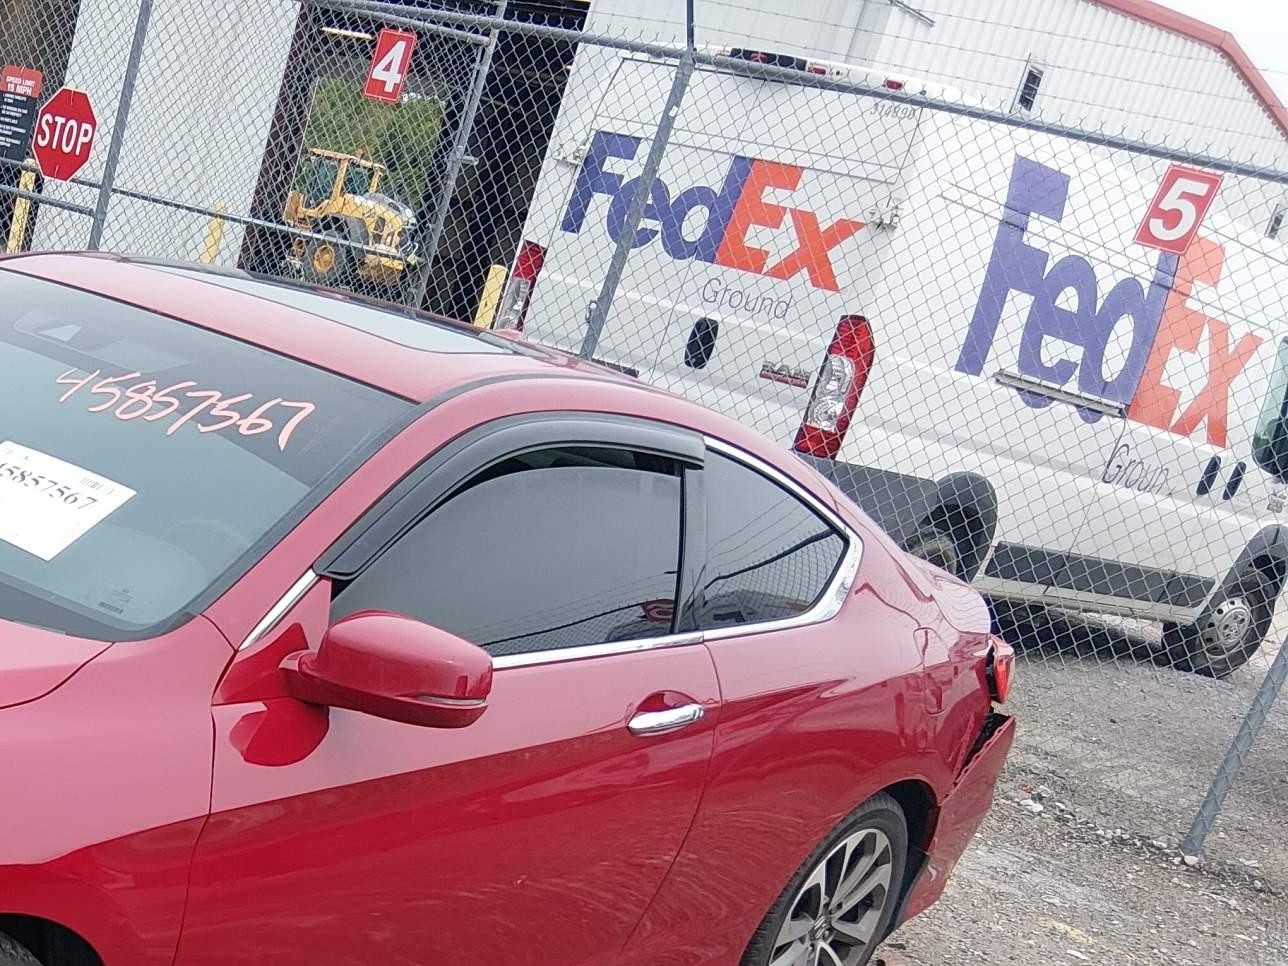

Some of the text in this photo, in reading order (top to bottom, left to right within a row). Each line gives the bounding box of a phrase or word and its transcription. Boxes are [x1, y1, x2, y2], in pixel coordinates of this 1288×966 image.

[6, 76, 36, 88] SPEED LIMIT
[7, 83, 33, 95] 15 MPH
[372, 41, 406, 93] 4
[37, 113, 93, 156] STOP
[560, 130, 869, 293] FedEx
[1148, 177, 1210, 242] 5
[702, 277, 794, 320] Ground
[954, 154, 1265, 449] FedEx
[55, 368, 315, 451] 45857567
[1102, 443, 1176, 496] Groun
